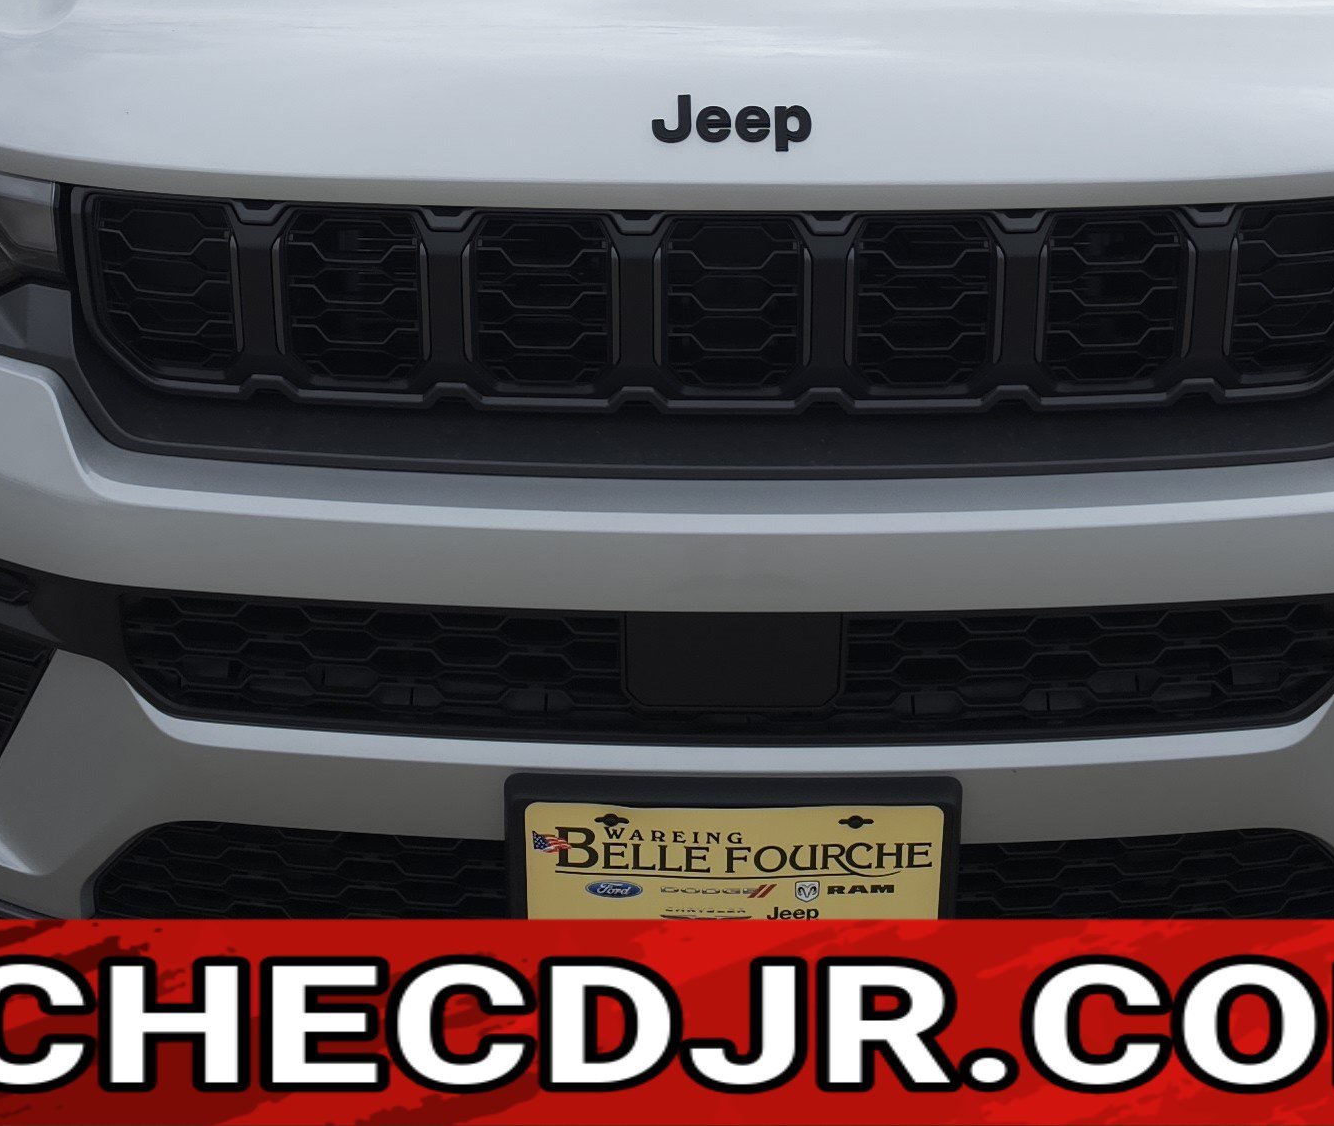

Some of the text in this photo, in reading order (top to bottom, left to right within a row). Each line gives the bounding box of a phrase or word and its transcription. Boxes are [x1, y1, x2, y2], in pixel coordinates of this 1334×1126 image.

[651, 94, 812, 152] Jeep
[604, 826, 744, 845] WAREING
[555, 826, 933, 877] BELLE FOURCHE
[826, 884, 895, 895] RAM
[766, 906, 820, 921] Jeep
